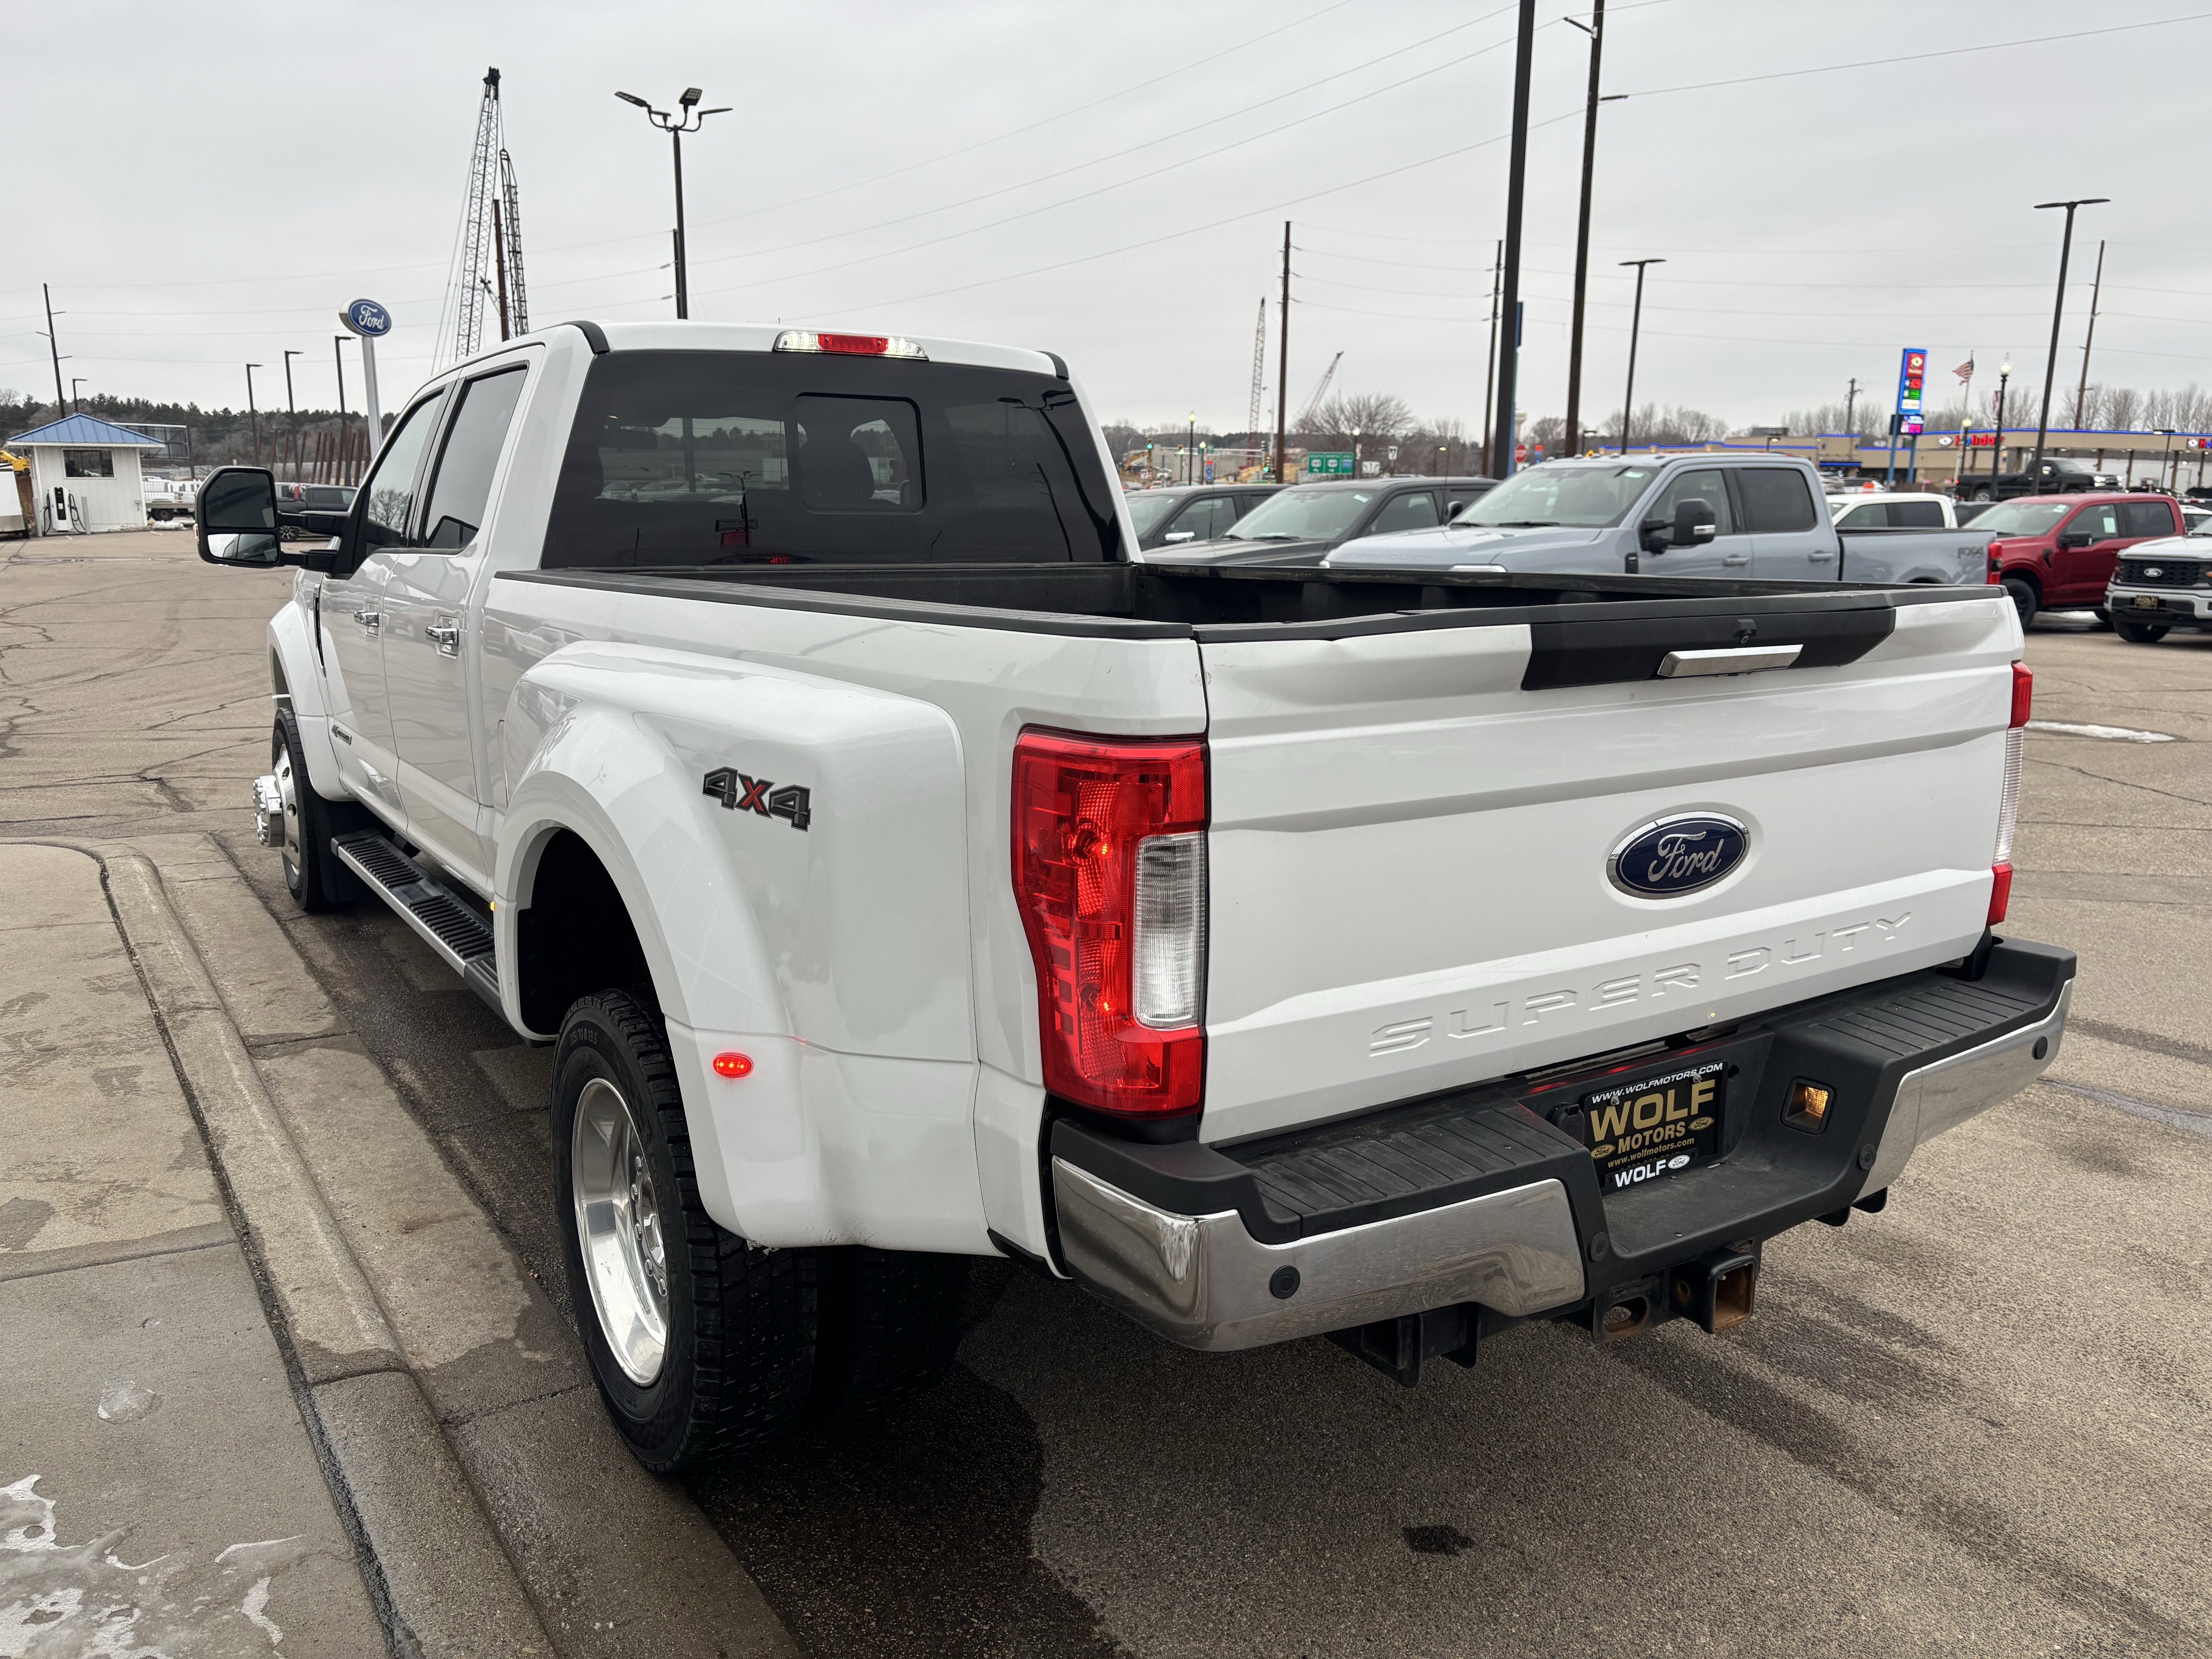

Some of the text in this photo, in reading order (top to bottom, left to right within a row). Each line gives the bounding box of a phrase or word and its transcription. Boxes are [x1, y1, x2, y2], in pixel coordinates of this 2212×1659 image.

[359, 305, 384, 330] Ford
[1515, 449, 1527, 458] STOP
[1958, 546, 1984, 559] FX4
[1648, 831, 1724, 882] Ford
[1369, 911, 1912, 1057] SUPER DUTY
[1592, 1063, 1723, 1103] WWW.WOLFMOTORS.COM
[1590, 1079, 1716, 1142] WOLF
[1607, 1138, 1695, 1168] www.wolfmotors.com
[1618, 1121, 1686, 1154] MOTORS
[1615, 1159, 1666, 1188] WOLF
